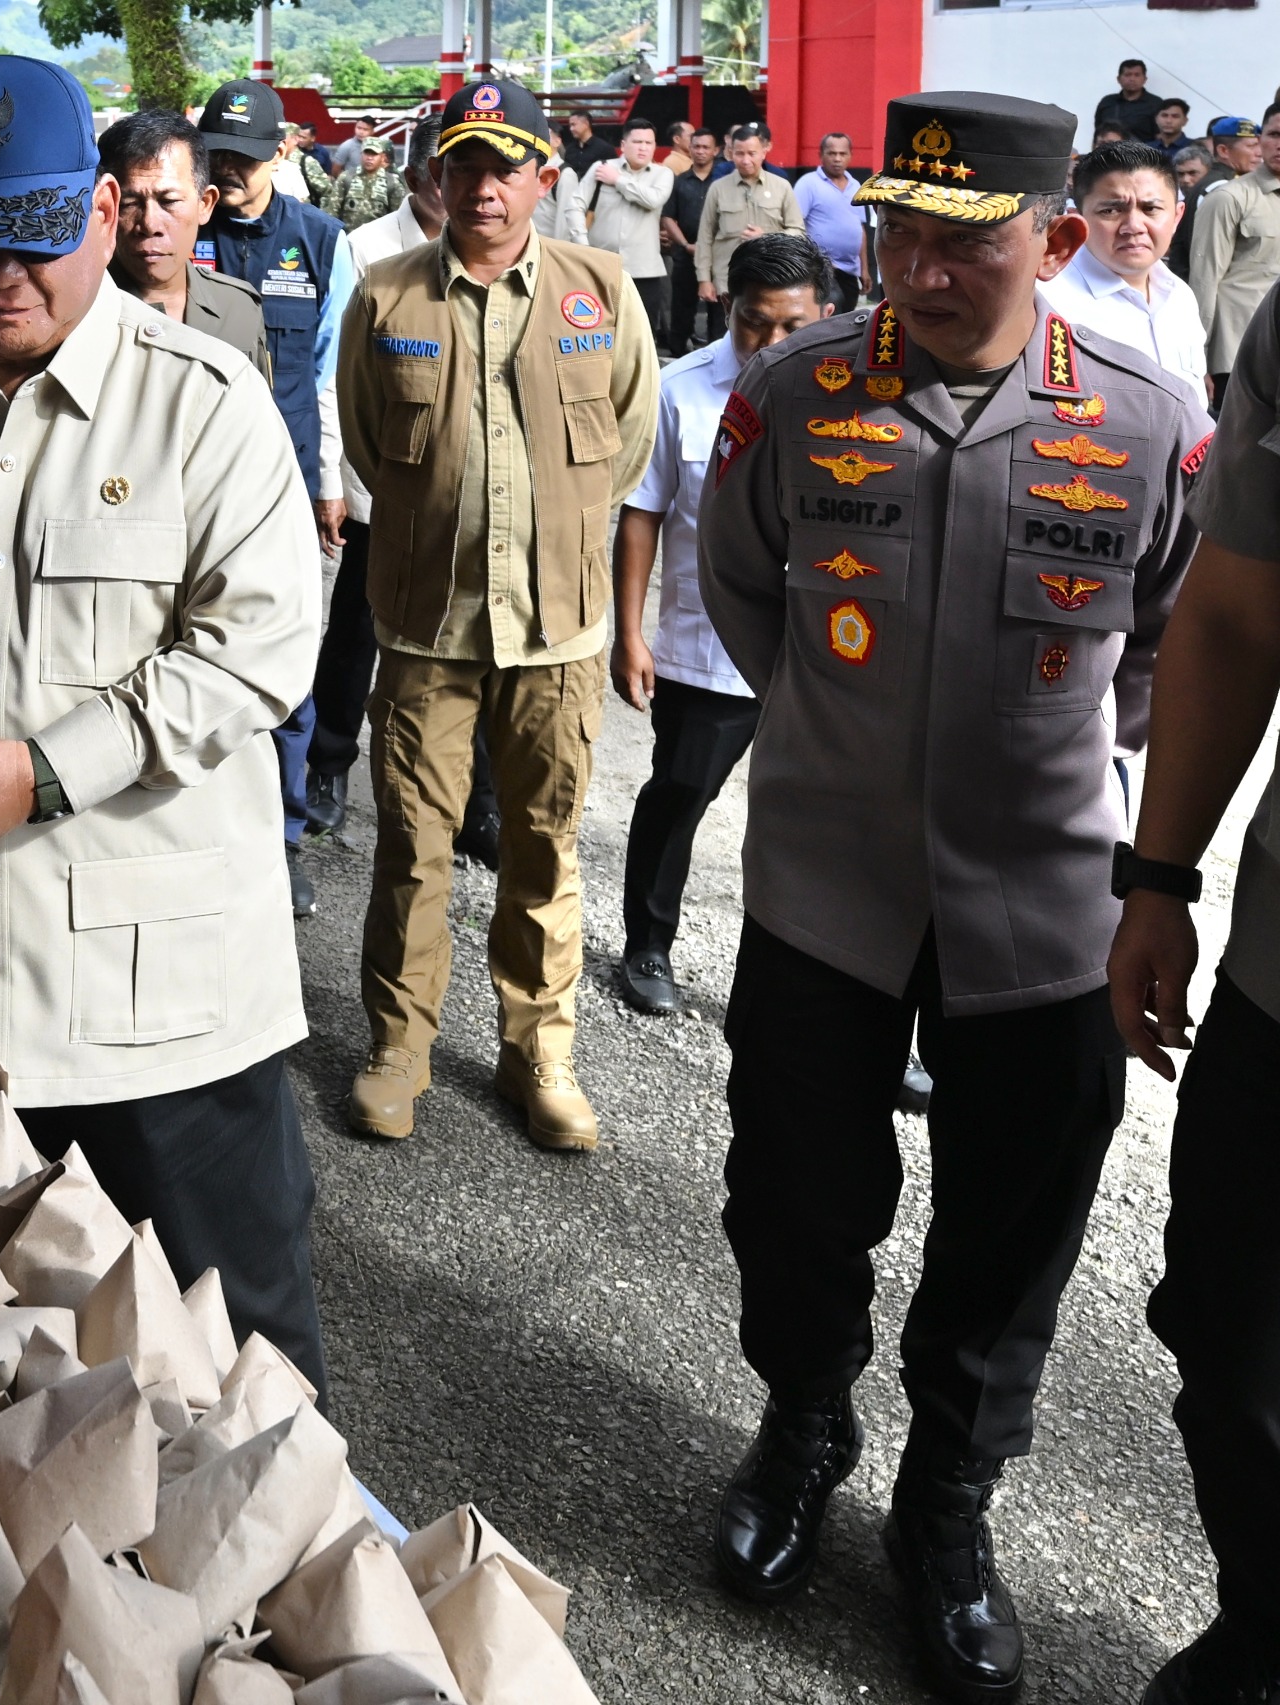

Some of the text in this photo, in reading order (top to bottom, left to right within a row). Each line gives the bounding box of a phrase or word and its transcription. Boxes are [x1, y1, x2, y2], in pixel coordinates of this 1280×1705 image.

[264, 284, 287, 292] MENTERI
[287, 285, 306, 294] SOSIAL
[558, 332, 612, 354] BNPB
[799, 495, 902, 527] L.SIGIT.P
[1025, 518, 1126, 558] POLRI
